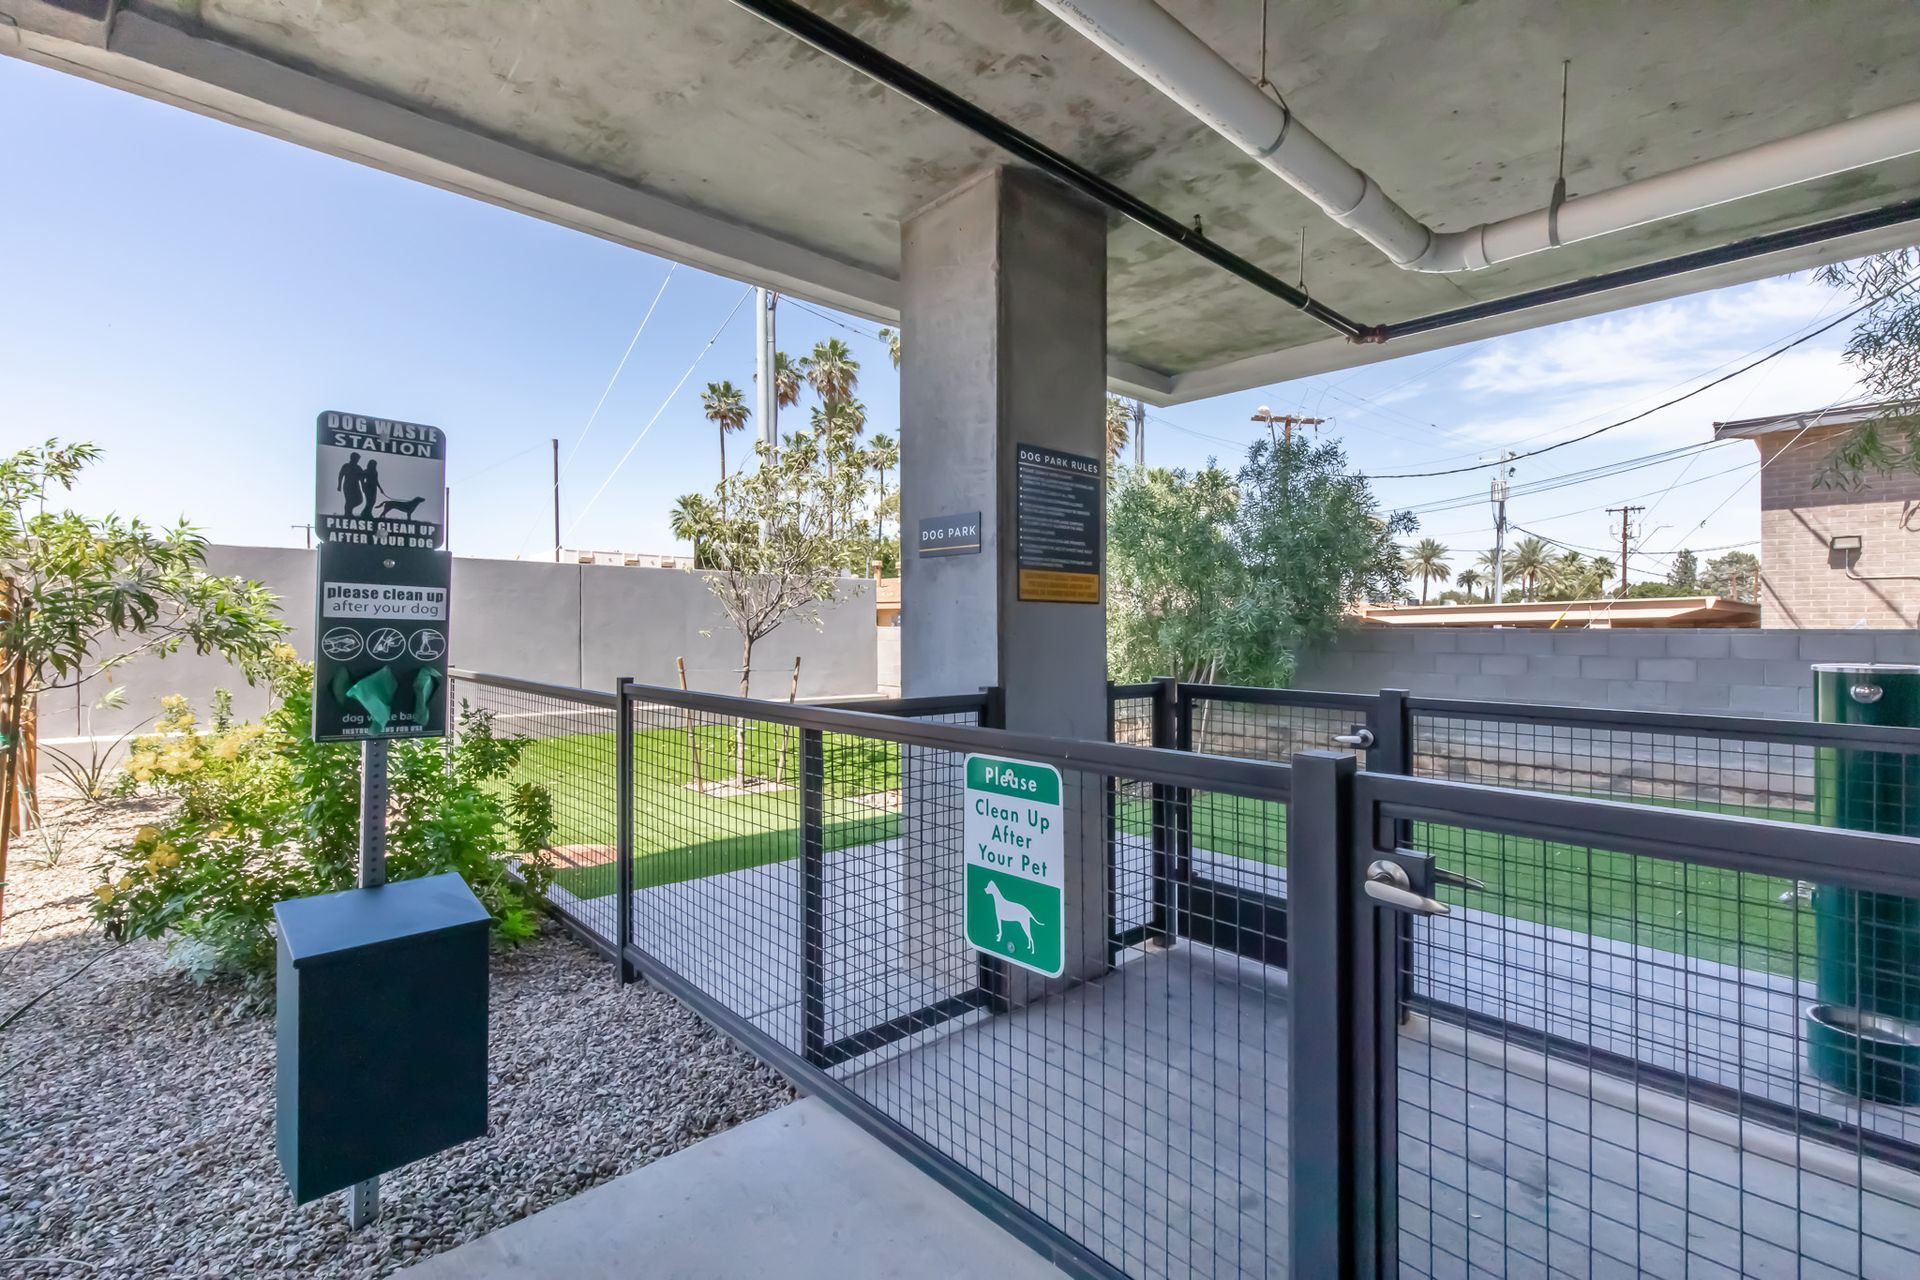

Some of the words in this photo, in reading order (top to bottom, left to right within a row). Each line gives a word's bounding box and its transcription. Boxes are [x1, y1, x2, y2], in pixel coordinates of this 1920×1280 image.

[328, 413, 367, 433] DOG
[375, 420, 437, 442] WASTE
[335, 433, 431, 457] STATION
[1020, 450, 1041, 462] DOG
[1044, 455, 1068, 467] PARK
[1071, 461, 1098, 473] RULES
[326, 518, 373, 531] PLEASE
[377, 522, 415, 534] CLEAN
[420, 525, 435, 535] UP
[922, 529, 944, 541] DOG
[948, 525, 976, 538] PARK
[329, 532, 367, 544] AFTER
[372, 534, 405, 546] YOUR
[409, 538, 433, 548] DOG
[327, 586, 379, 599] please
[383, 588, 422, 601] clean
[427, 591, 443, 603] up
[332, 600, 369, 612] after
[373, 603, 406, 615] your
[410, 603, 439, 617] dog
[342, 713, 364, 724] dog
[985, 766, 1037, 792] Please
[975, 798, 1019, 823] Clean
[1028, 808, 1050, 834] Up
[991, 824, 1032, 849] After
[978, 843, 1013, 867] Your
[1021, 854, 1047, 877] Pet
